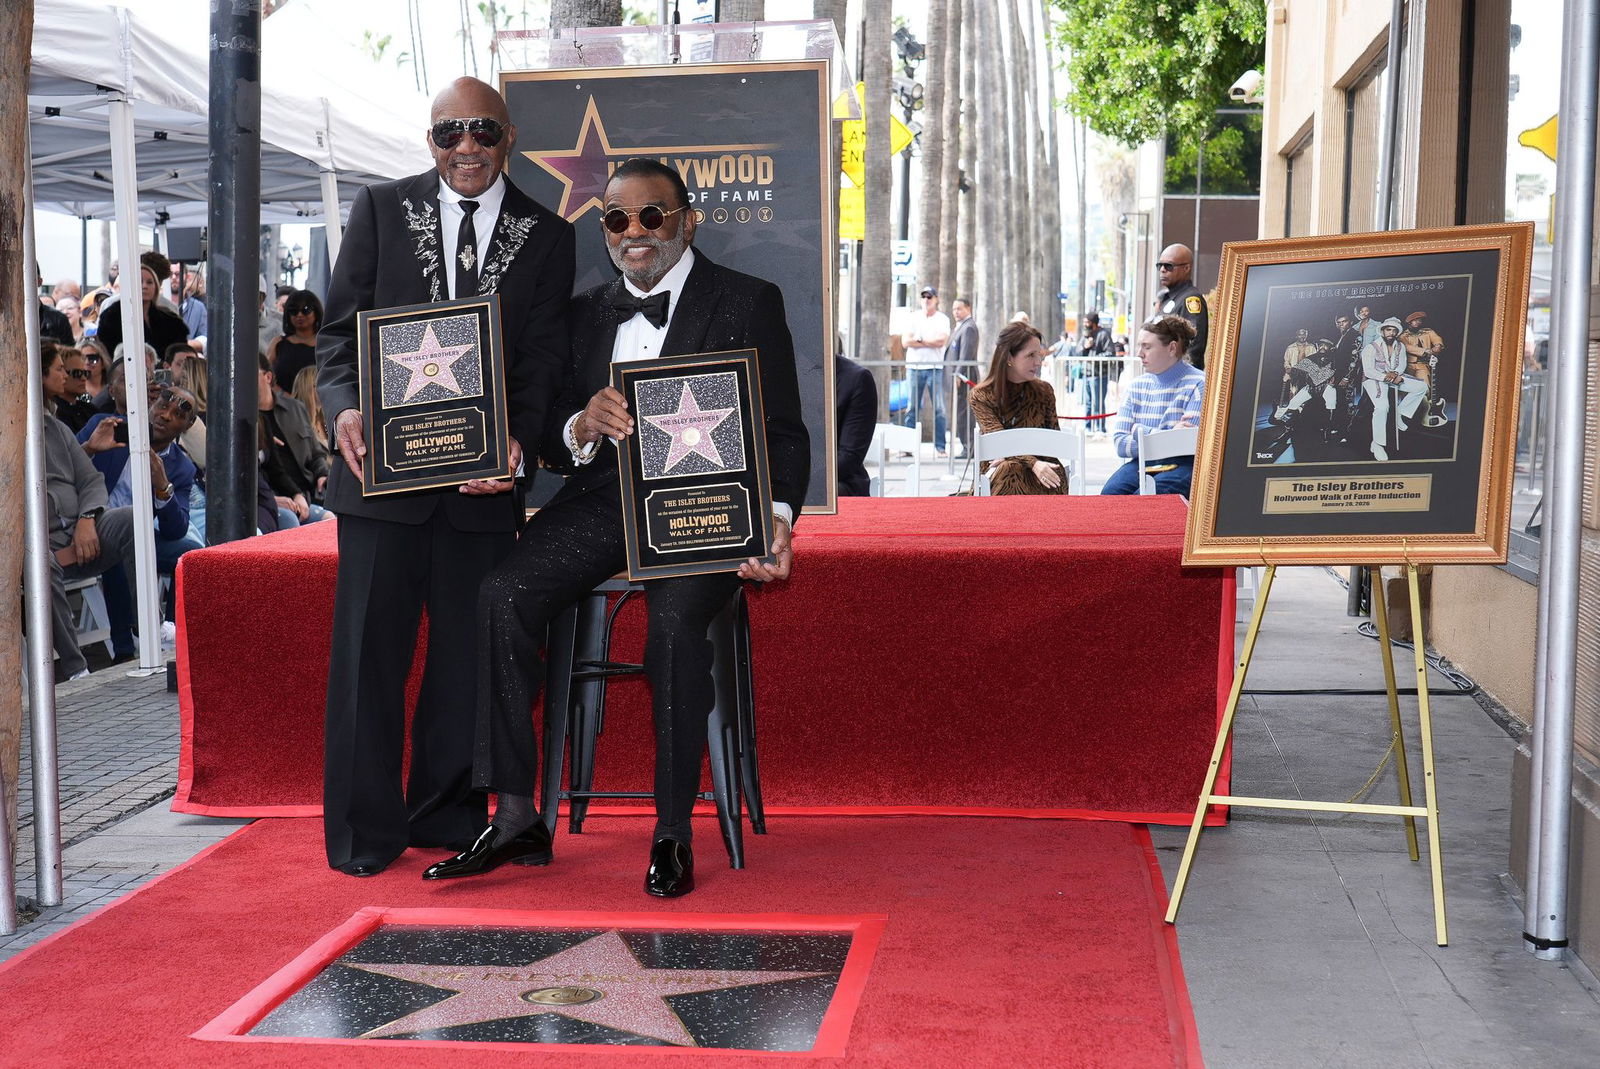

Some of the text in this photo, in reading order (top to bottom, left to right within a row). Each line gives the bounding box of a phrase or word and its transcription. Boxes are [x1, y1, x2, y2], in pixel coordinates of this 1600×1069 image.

[721, 190, 773, 202] FAME
[1351, 284, 1414, 296] BROTHERS
[430, 350, 460, 358] BROTHERS
[434, 417, 466, 427] BROTHERS
[689, 415, 720, 424] BROTHERS
[406, 434, 464, 450] HOLLYWOOD
[1292, 481, 1404, 492] The Isley Brothers
[697, 495, 730, 504] BROTHERS
[670, 513, 728, 529] HOLLYWOOD
